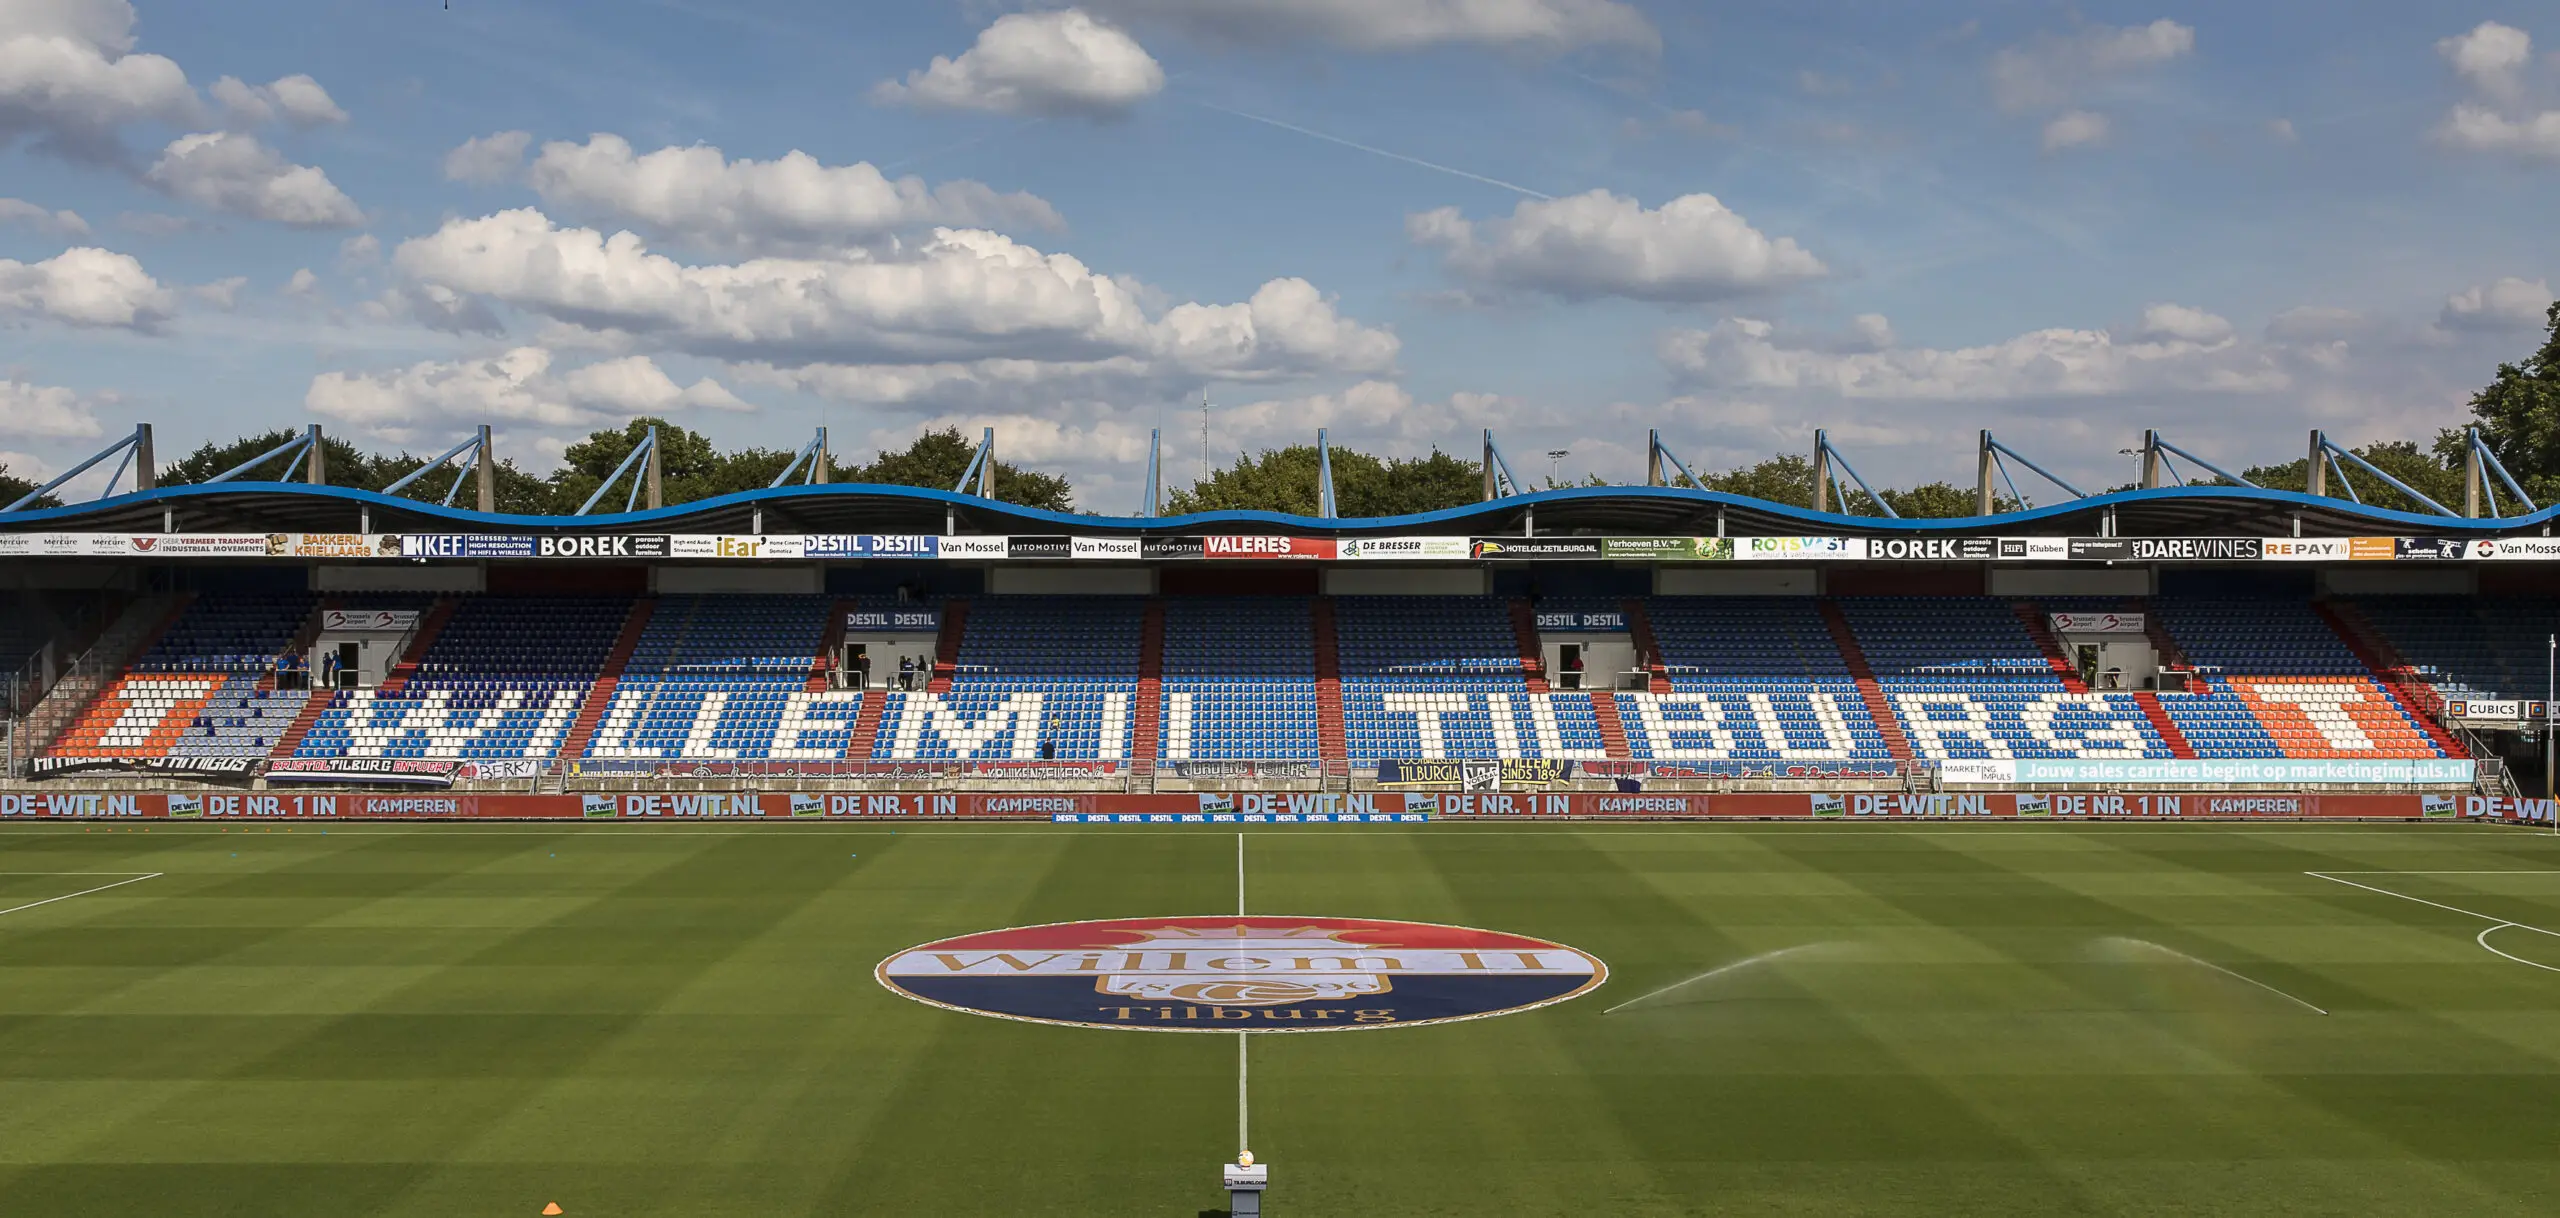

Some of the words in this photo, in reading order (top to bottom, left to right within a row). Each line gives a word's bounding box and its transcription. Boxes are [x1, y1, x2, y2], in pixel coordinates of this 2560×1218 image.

[44, 538, 78, 546] Mercure
[93, 538, 126, 546] Mercure
[302, 534, 364, 545] BAKKERIJ
[805, 535, 863, 551] DESTIL
[872, 535, 930, 552] DESTIL
[1206, 537, 1293, 553] VALERES
[1607, 539, 1652, 548] Verhoeven
[1653, 540, 1669, 548] B.V.
[295, 545, 372, 556] KRIELLAARS
[541, 536, 629, 556] BOREK
[940, 543, 962, 552] Van
[965, 542, 1005, 552] Mossel
[1074, 543, 1096, 552] Van
[1098, 542, 1138, 553] Mossel
[1363, 542, 1377, 550] DE
[1380, 542, 1421, 550] BRESSER
[1507, 545, 1597, 553] HOTELGILZETILBURG.NL
[1871, 538, 1958, 558] BOREK
[2029, 544, 2064, 553] Klubben
[2142, 539, 2258, 559] DAREWINES
[2265, 544, 2334, 555] REPAY
[2500, 544, 2522, 553] Van
[847, 614, 888, 625] DESTIL
[895, 614, 935, 625] DESTIL
[1537, 614, 1577, 626] DESTIL
[1584, 614, 1624, 626] DESTIL
[2469, 705, 2515, 715] CUBICS
[1382, 692, 2146, 760] TILBURG
[271, 760, 331, 771] BRISTOL
[330, 760, 392, 772] TILBURG
[393, 761, 453, 772] ANTWERP
[481, 761, 533, 778] BERRY
[1502, 758, 1551, 770] WILLEM
[1945, 765, 1997, 773] MARKETING
[1398, 765, 1462, 782] TILBURGIA
[1465, 768, 1499, 786] VOETBAL
[1501, 768, 1533, 780] SINDS
[2026, 763, 2072, 778] Jouw
[2079, 763, 2123, 777] sales
[2128, 761, 2197, 778] carrière
[2201, 762, 2260, 781] begint
[2263, 766, 2286, 781] op
[2291, 762, 2466, 782] marketingimpuls.nl
[1, 795, 142, 816] DE-WIT.NL
[171, 803, 183, 811] DE
[183, 802, 199, 810] WIT
[209, 796, 240, 815] DE
[247, 796, 286, 815] NR.
[292, 796, 304, 815] 1
[312, 796, 337, 815] IN
[366, 799, 456, 813] KAMPEREN
[586, 803, 597, 811] DE
[598, 802, 614, 810] WIT
[626, 795, 765, 816] DE-WIT.NL
[794, 803, 807, 811] DE
[807, 802, 821, 810] WIT
[832, 796, 861, 815] DE
[867, 796, 907, 815] NR.
[913, 796, 924, 815] 1
[933, 796, 956, 815] IN
[986, 799, 1074, 813] KAMPEREN
[1215, 801, 1230, 809] WIT
[1242, 794, 1380, 814] DE-WIT.NL
[1408, 802, 1419, 810] DE
[1420, 801, 1436, 809] WIT
[1445, 796, 1475, 815] DE
[1481, 796, 1520, 815] NR.
[1527, 796, 1538, 815] 1
[1546, 796, 1570, 815] IN
[1599, 799, 1687, 813] KAMPEREN
[1815, 803, 1827, 811] DE
[1827, 801, 1841, 810] WIT
[1854, 795, 1991, 816] DE-WIT.NL
[2019, 803, 2032, 811] DE
[2032, 801, 2047, 810] WIT
[2057, 796, 2086, 815] DE
[2092, 796, 2132, 815] NR.
[2138, 796, 2149, 815] 1
[2157, 796, 2181, 815] IN
[2210, 799, 2299, 813] KAMPEREN
[2425, 803, 2438, 811] DE
[2438, 802, 2452, 811] WIT
[1056, 814, 1079, 822] DESTIL
[1087, 814, 1110, 822] DESTIL
[1118, 814, 1141, 822] DESTIL
[1150, 814, 1173, 822] DESTIL
[1181, 814, 1204, 822] DESTIL
[1213, 814, 1236, 822] DESTIL
[1244, 814, 1267, 822] DESTIL
[1275, 814, 1298, 822] DESTIL
[1306, 814, 1329, 822] DESTIL
[1337, 814, 1360, 822] DESTIL
[1369, 814, 1392, 822] DESTIL
[1401, 814, 1424, 822] DESTIL
[925, 952, 1415, 972] Willem
[1444, 952, 1553, 971] II
[1098, 1005, 1397, 1024] Tilburg
